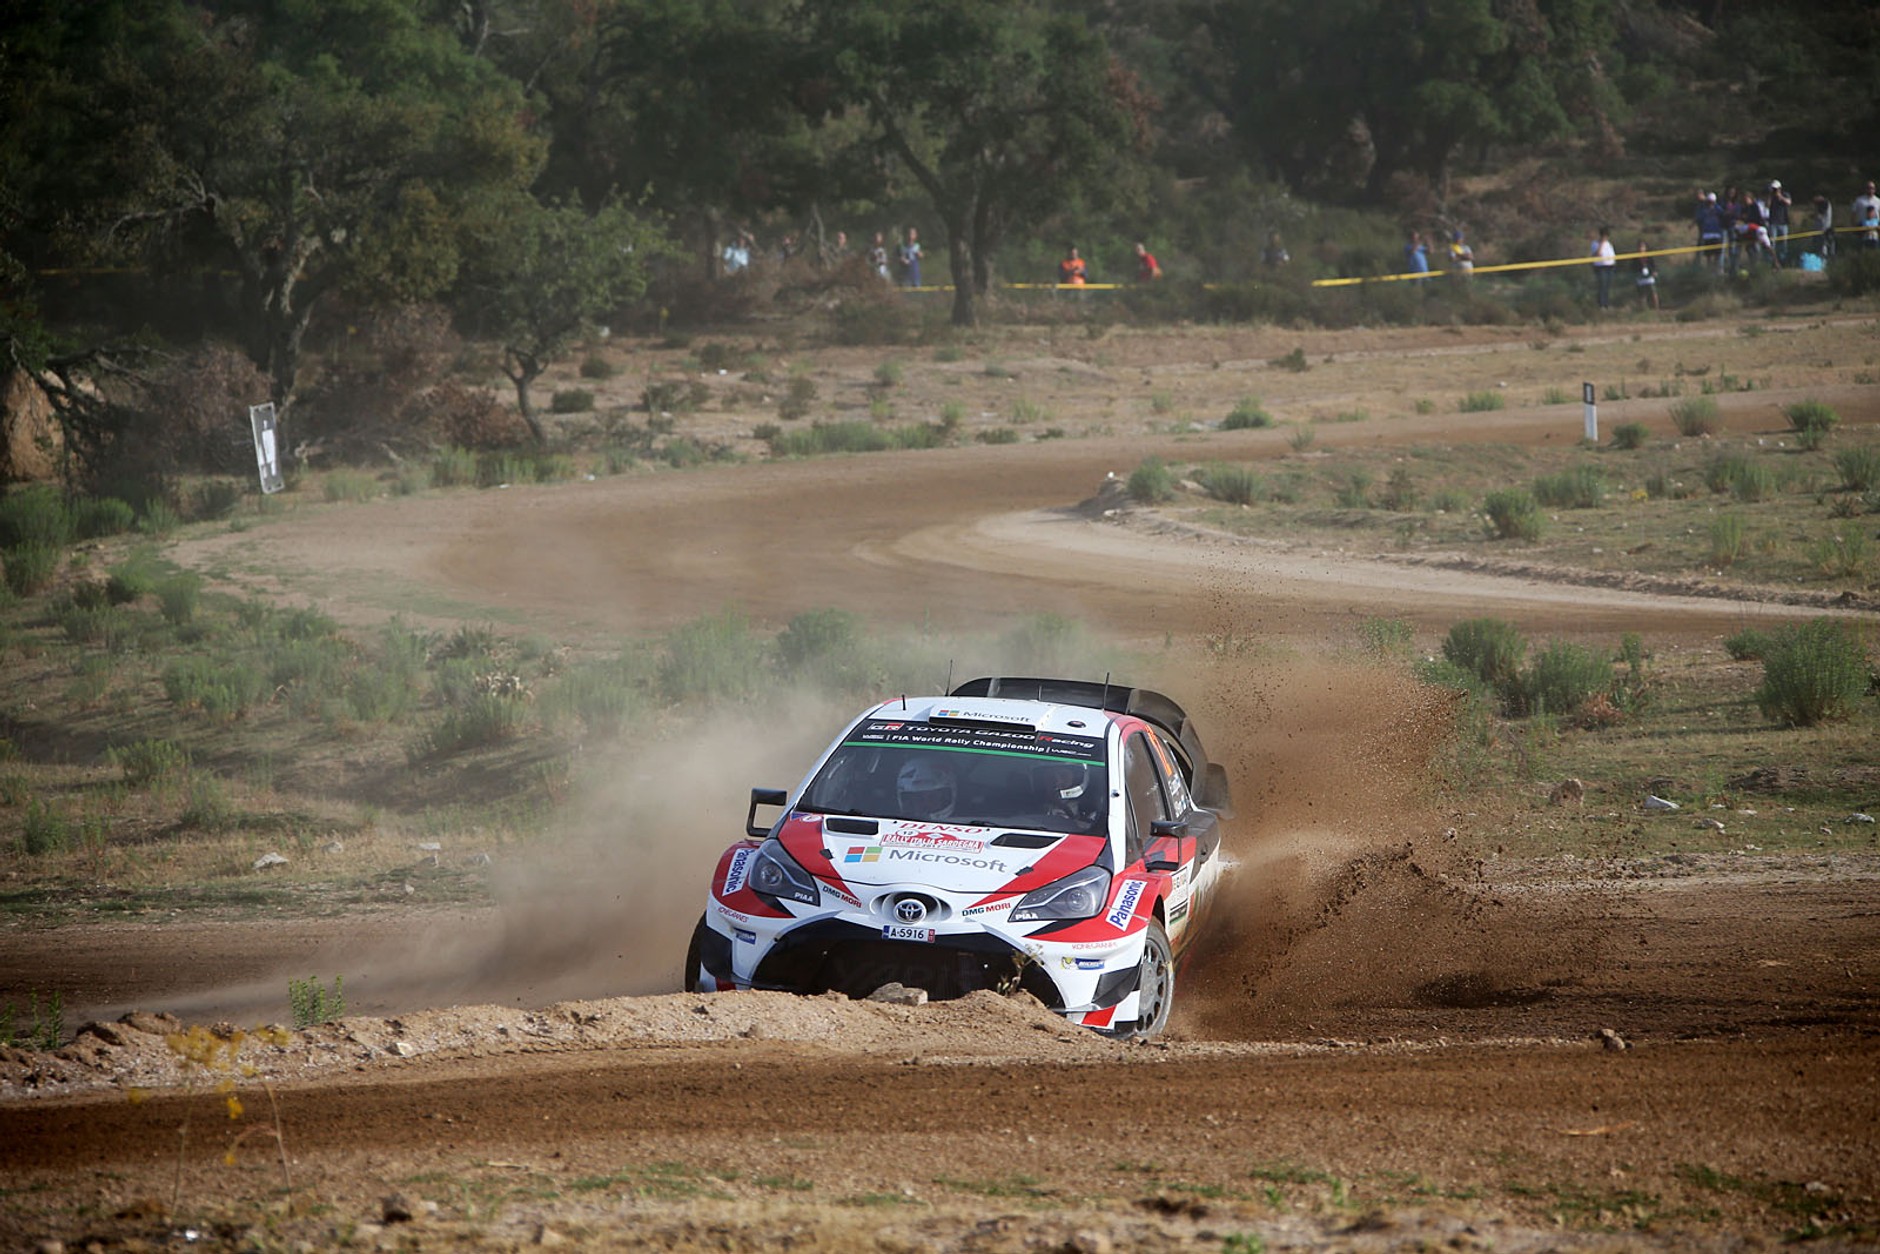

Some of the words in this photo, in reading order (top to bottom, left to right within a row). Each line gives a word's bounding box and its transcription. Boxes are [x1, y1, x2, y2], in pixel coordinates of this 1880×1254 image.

[963, 711, 1030, 722] Microsoft
[906, 725, 971, 734] TOYOTA
[975, 729, 1035, 740] GAZOO
[1040, 735, 1094, 748] Racing
[973, 739, 1045, 753] Championship
[900, 823, 982, 834] DENSO
[884, 834, 910, 844] RALLY
[936, 839, 979, 849] SARDEGNA
[889, 849, 1007, 873] Microsoft
[794, 892, 813, 902] PIAA
[822, 885, 840, 899] DMG
[841, 894, 862, 908] MORI
[962, 907, 984, 917] DMG
[985, 902, 1011, 913] MORI
[1109, 881, 1143, 928] Panasonic
[1015, 911, 1038, 920] PIAA
